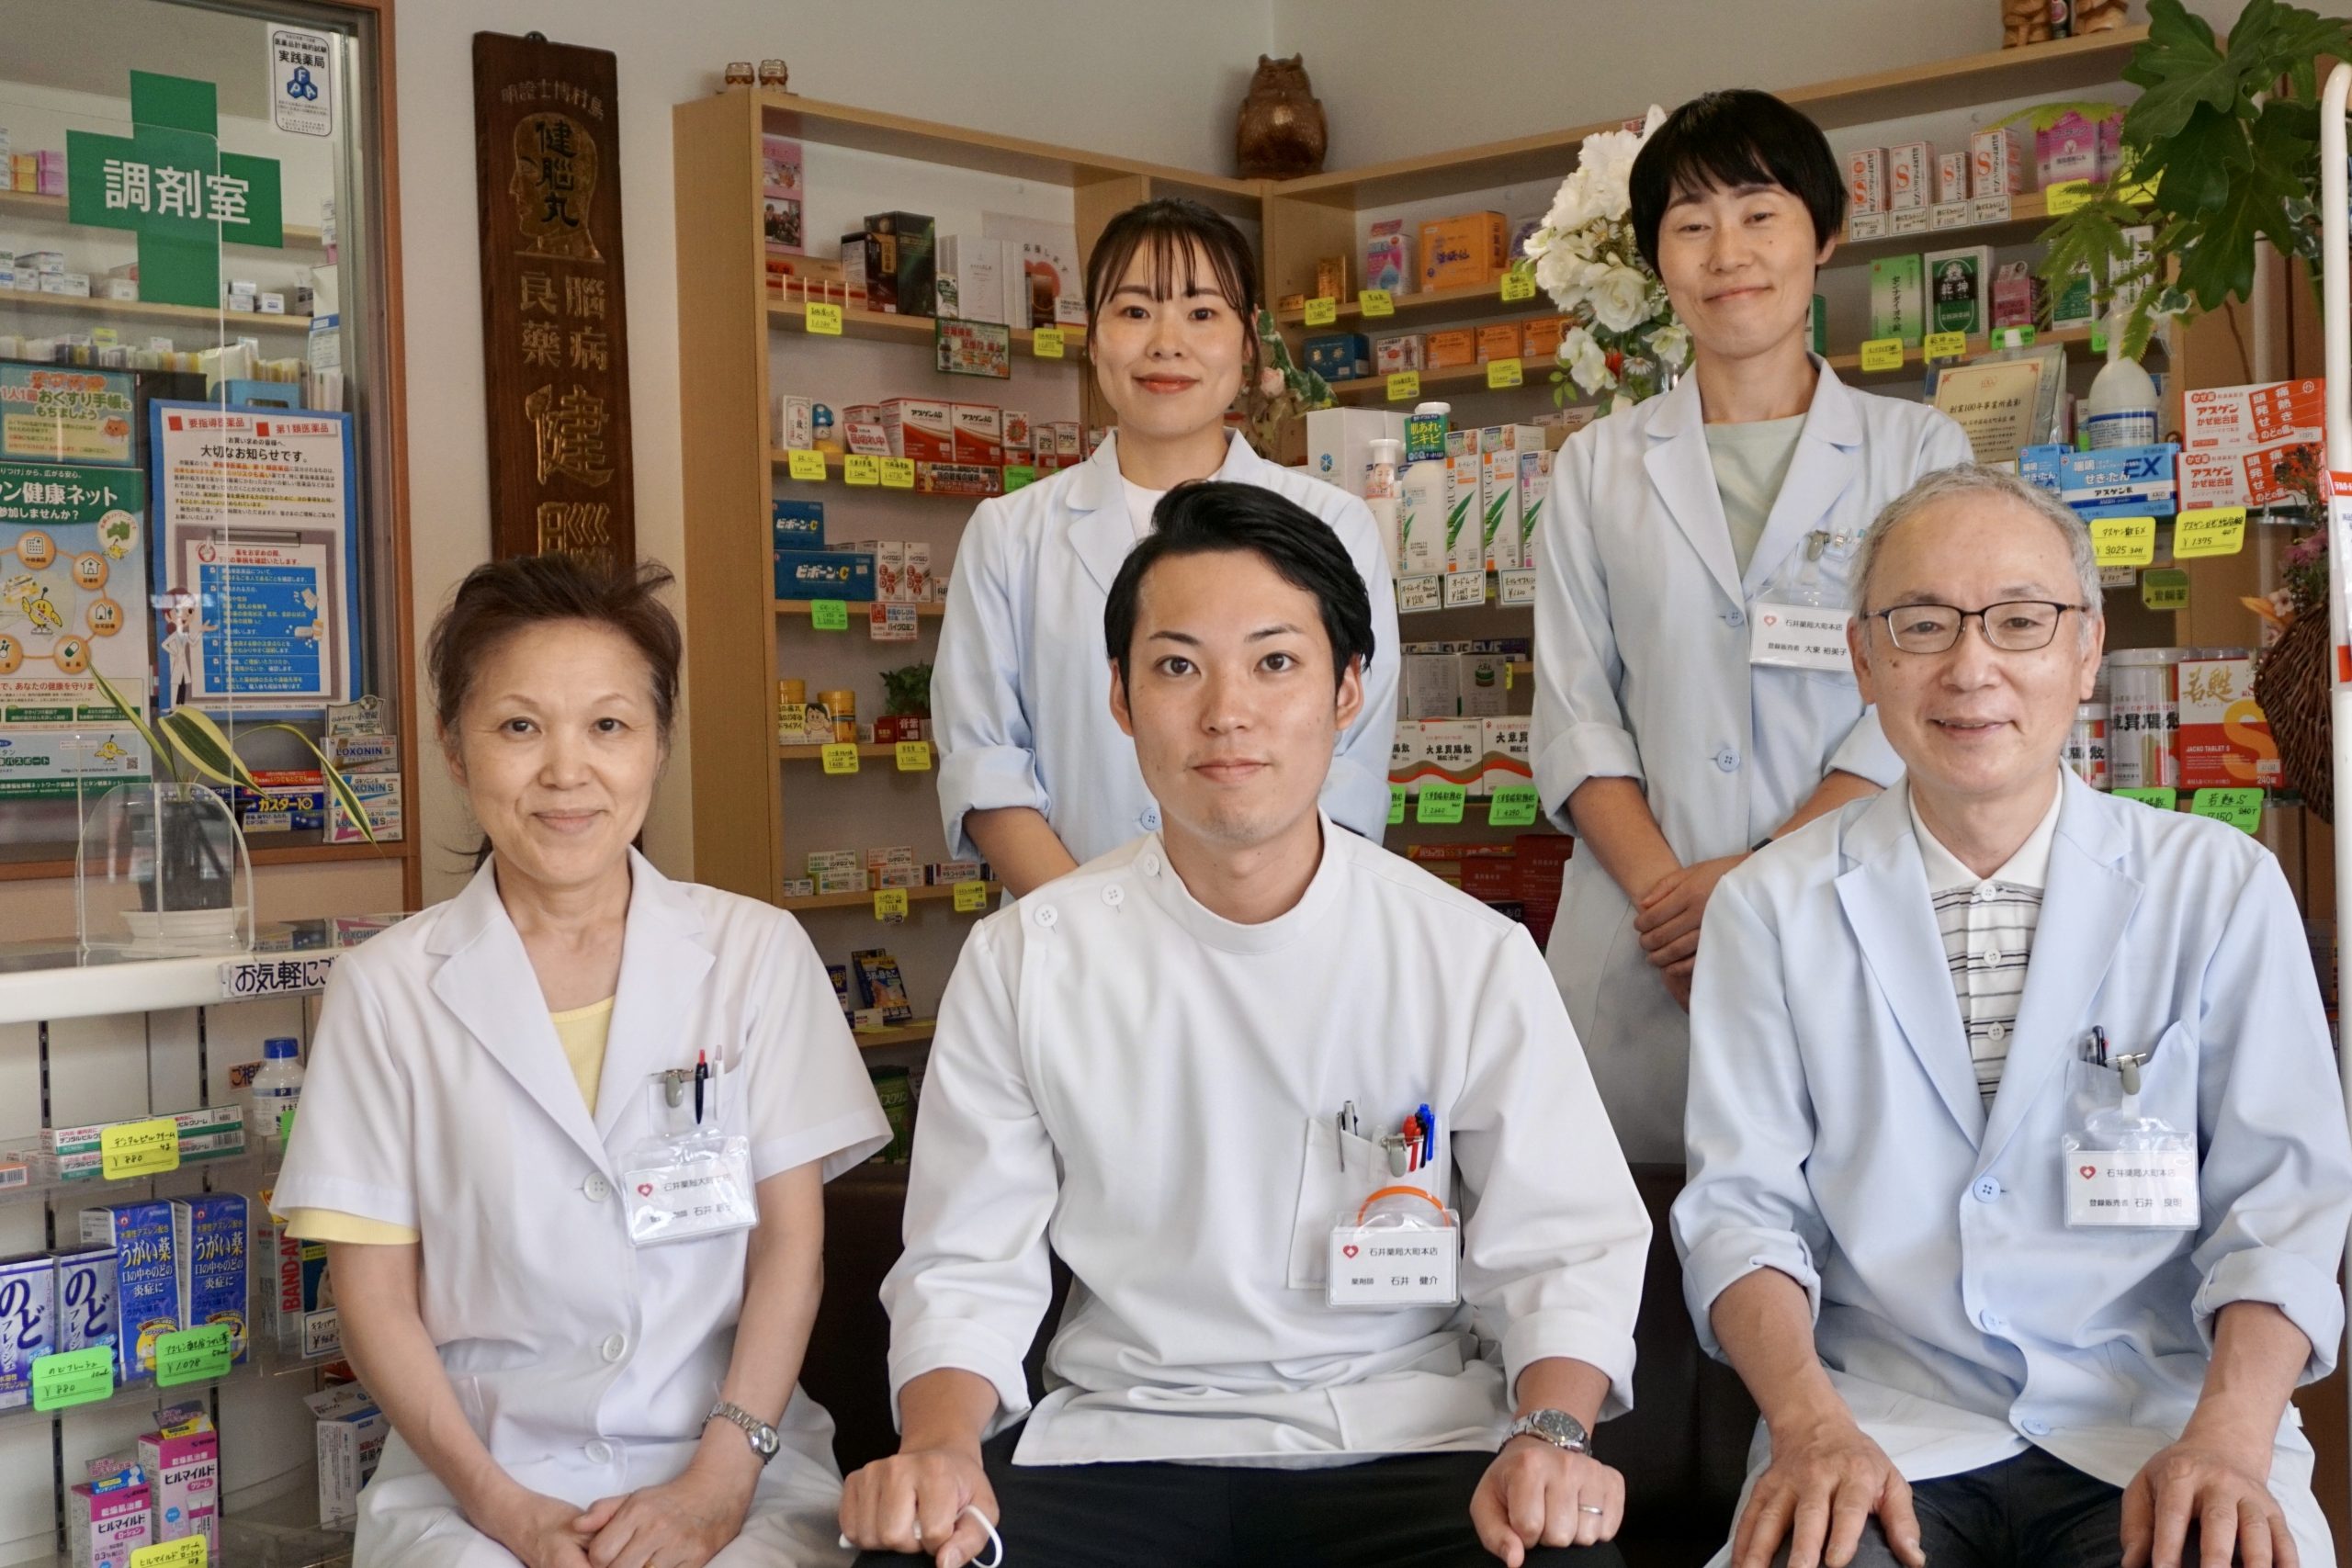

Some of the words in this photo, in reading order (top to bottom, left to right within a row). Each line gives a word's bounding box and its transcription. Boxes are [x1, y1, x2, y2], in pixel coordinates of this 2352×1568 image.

[278, 50, 325, 69] 実践薬局
[1943, 164, 1955, 182] S
[1977, 152, 1991, 176] S
[1896, 164, 1910, 189] S
[103, 159, 251, 225] 調剤室
[2196, 403, 2239, 415] アスゲン
[2197, 414, 2240, 426] かぜ総合錠
[1410, 433, 1442, 445] ニキビ
[200, 444, 307, 463] 大切なお知らせです。
[2123, 455, 2163, 479] EX
[2191, 466, 2233, 479] アスゲン
[1447, 468, 1456, 511] MUGE
[1485, 464, 1494, 508] MUGE
[2191, 478, 2233, 489] かぜ総合錠
[0, 480, 118, 507] ン健康ネット
[336, 746, 382, 756] LOXONIN
[384, 746, 390, 755] S
[387, 784, 394, 792] S
[259, 797, 313, 812] ガスター10
[232, 1063, 263, 1087] ご相
[694, 1206, 712, 1217] 石井
[2134, 1199, 2154, 1208] 石井
[120, 1236, 172, 1269] うがい薬
[196, 1231, 243, 1260] うがい薬
[1370, 1247, 1438, 1258] 石井薬局大町本店
[122, 1265, 173, 1283] 口の中やのどの
[195, 1259, 243, 1275] 口の中やのどの
[205, 1276, 234, 1290] 炎症に
[1351, 1278, 1374, 1286] 薬剤師
[1391, 1276, 1409, 1286] 石井
[1419, 1276, 1439, 1286] 健介
[133, 1283, 164, 1298] 炎症に
[65, 1269, 109, 1337] のど
[0, 1279, 45, 1349] のど
[172, 1451, 209, 1466] 乾燥肌治療
[164, 1464, 215, 1485] ヒルマイルド
[191, 1481, 210, 1490] クリーム
[101, 1499, 142, 1517] 乾燥肌治療
[98, 1514, 146, 1534] ヒルマイルド
